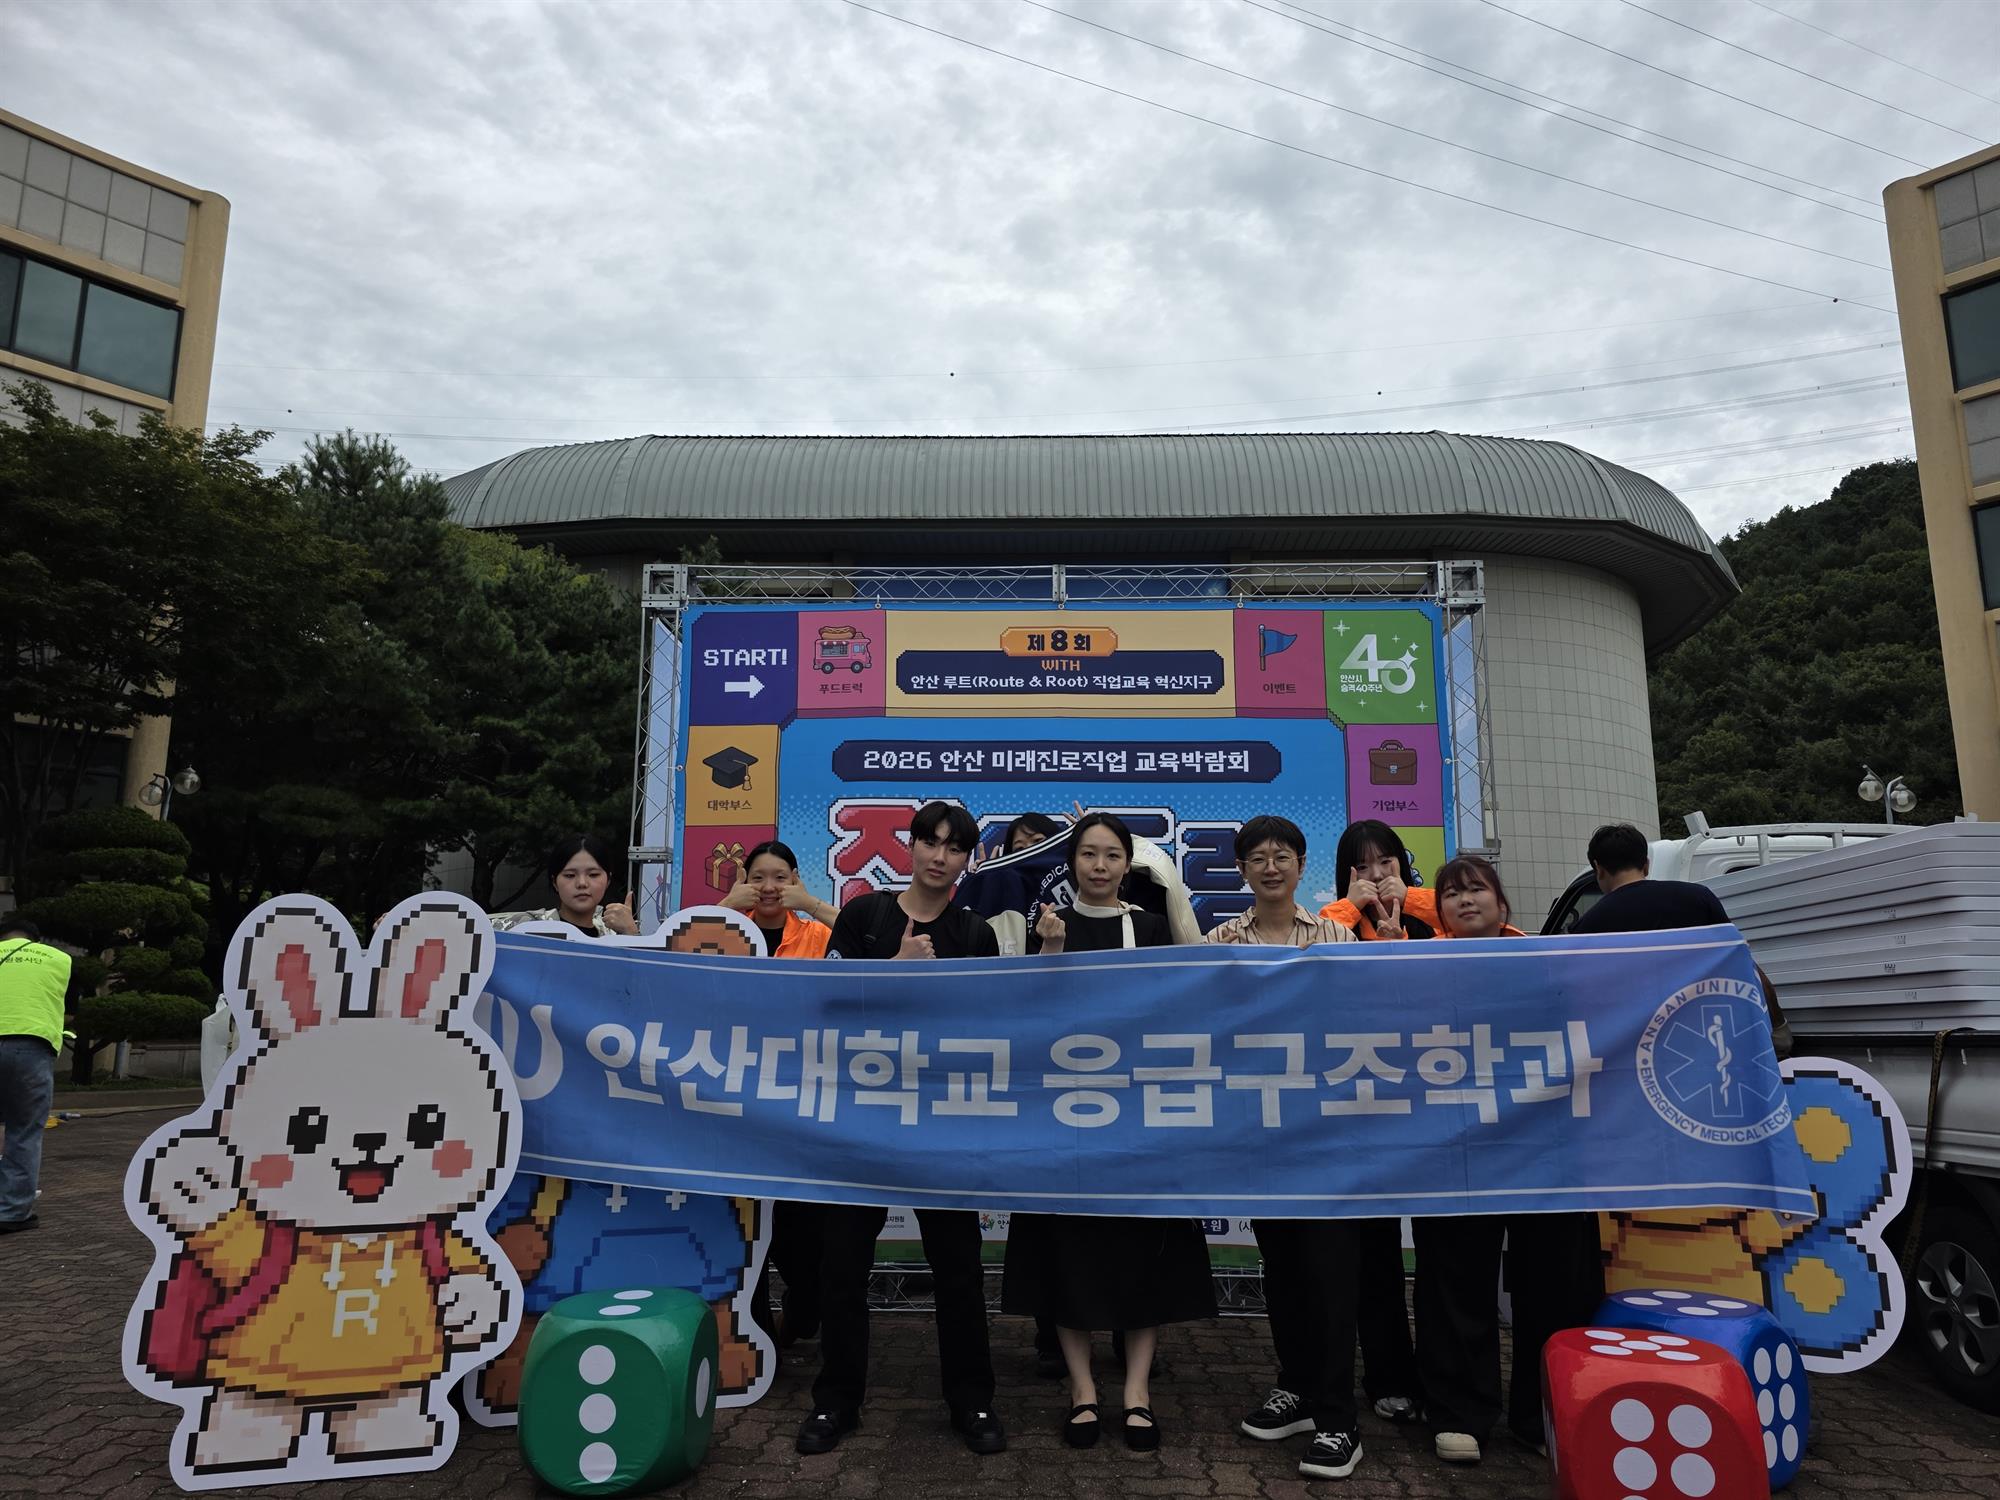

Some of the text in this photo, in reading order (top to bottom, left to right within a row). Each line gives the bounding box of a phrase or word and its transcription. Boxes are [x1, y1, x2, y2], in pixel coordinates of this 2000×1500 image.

[1027, 630, 1091, 651] 제 8 회
[703, 648, 788, 667] START!
[1041, 659, 1081, 671] WITH
[911, 675, 940, 689] 안산
[1029, 676, 1042, 687] &
[1046, 675, 1089, 688] Root)
[1092, 675, 1150, 689] 직업교육
[1154, 675, 1213, 689] 혁신지구
[1340, 674, 1363, 683] 안산시
[819, 682, 863, 695] 푸드트럭
[1263, 682, 1297, 695] 이벤트
[1340, 683, 1383, 693] 승격40주년
[864, 750, 1249, 773] 2026 안산 미래진로직업 교육박람회
[707, 799, 753, 811] 대학부스
[1372, 800, 1421, 812] 기업부스
[1040, 862, 1070, 896] EDICA
[1642, 980, 1761, 1053] ANSAN UNIVE
[585, 1020, 1603, 1128] 안산대학교 응급구조학과
[1640, 1067, 1698, 1134] EMERGENCY
[1700, 1129, 1761, 1142] MEDICAL
[332, 1288, 380, 1338] R
